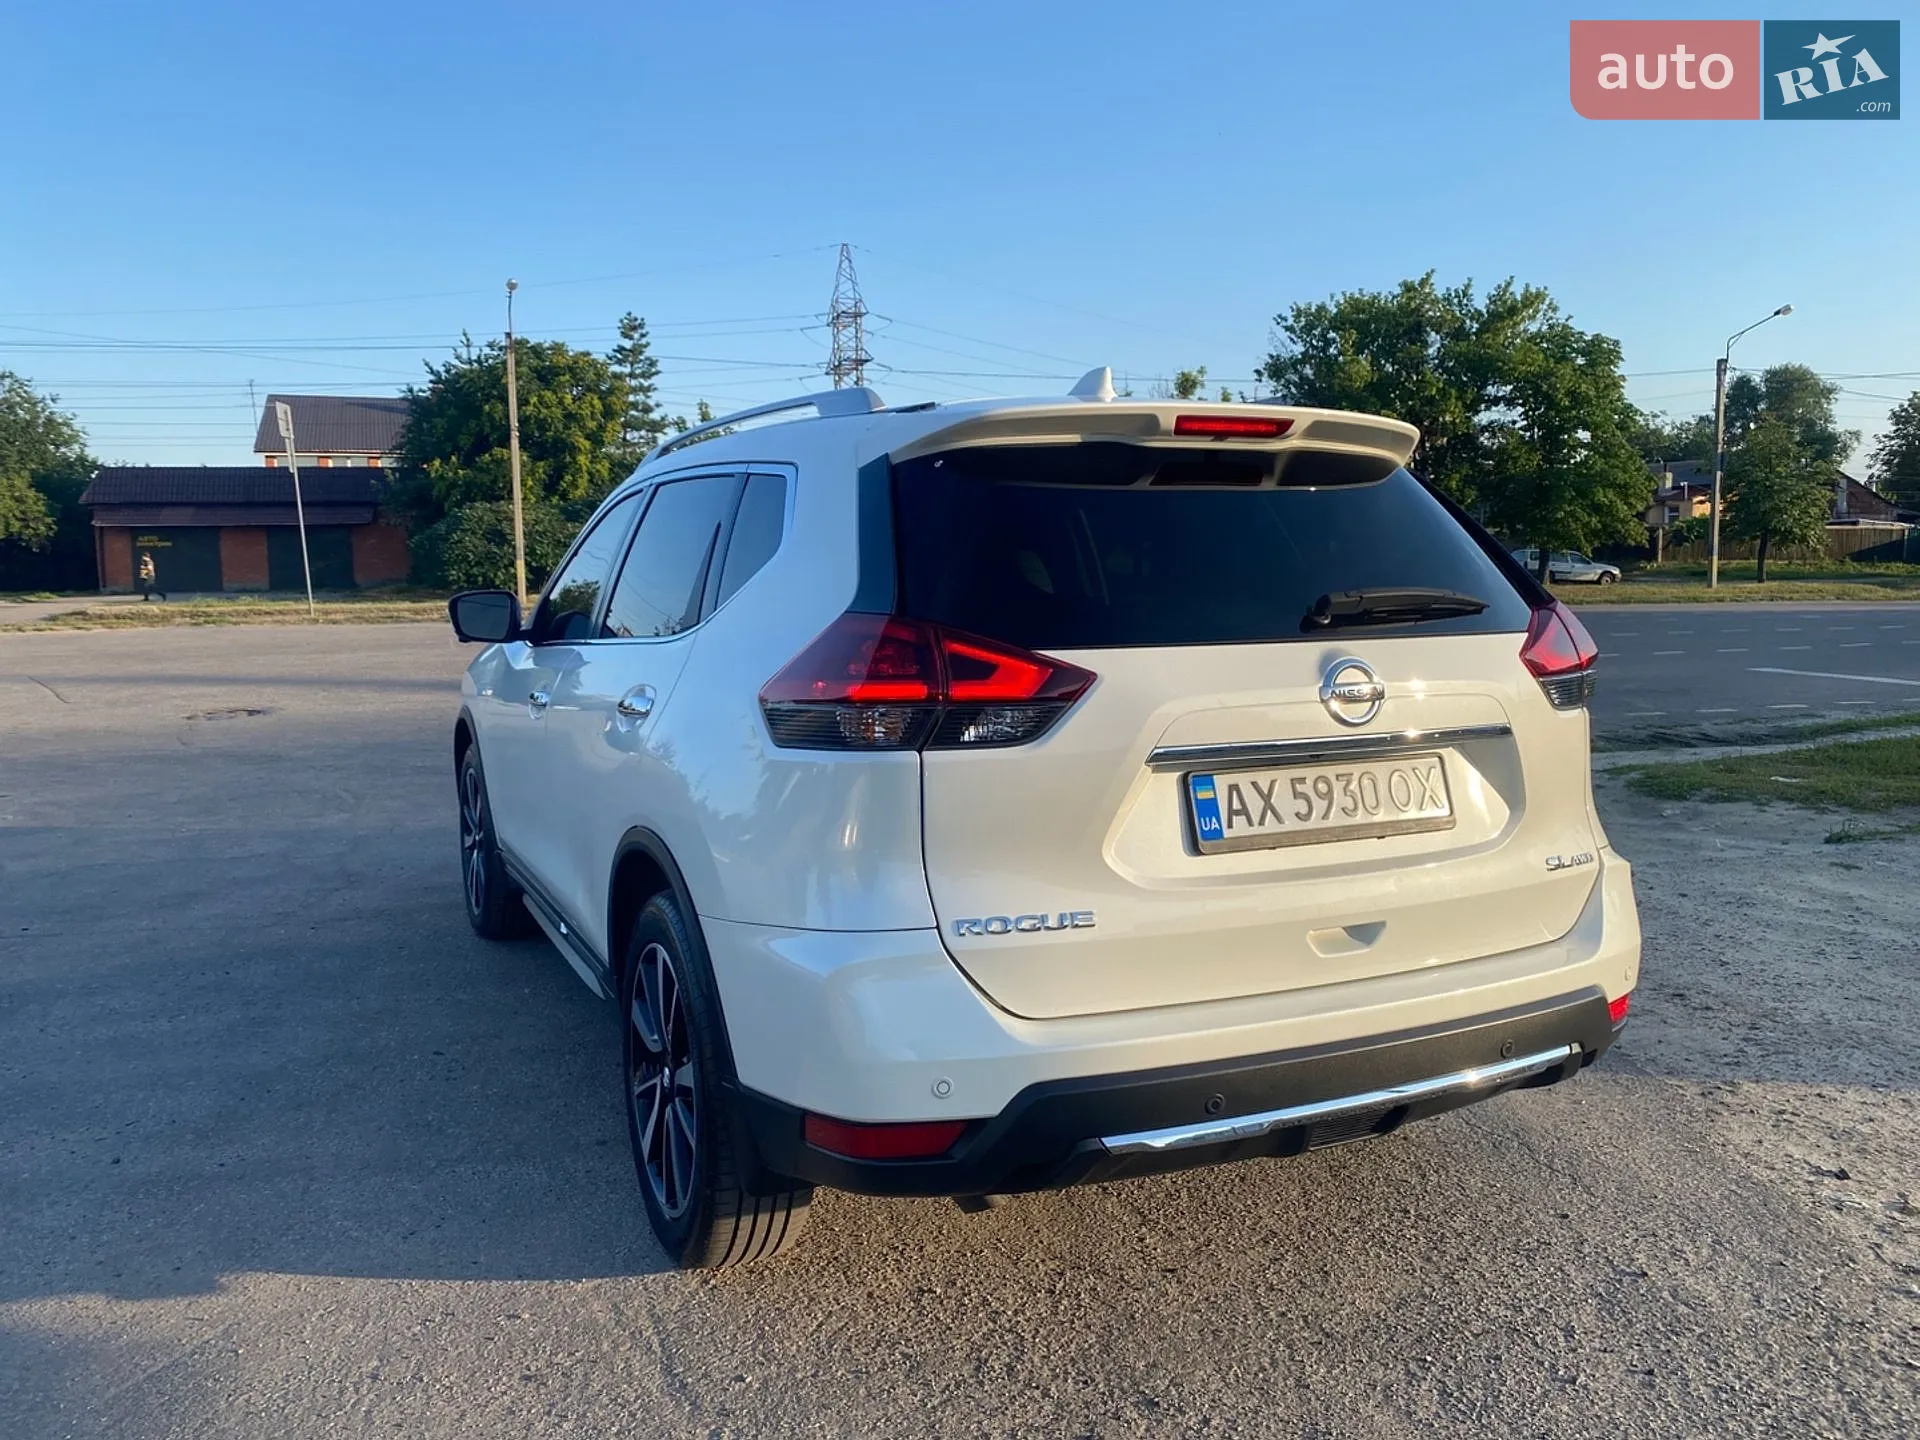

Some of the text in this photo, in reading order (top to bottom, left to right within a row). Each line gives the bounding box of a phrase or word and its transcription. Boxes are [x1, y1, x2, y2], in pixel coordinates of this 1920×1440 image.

[1227, 767, 1444, 829] AX 5930 OX
[1201, 816, 1220, 832] UA
[953, 910, 1096, 936] ROGUE
